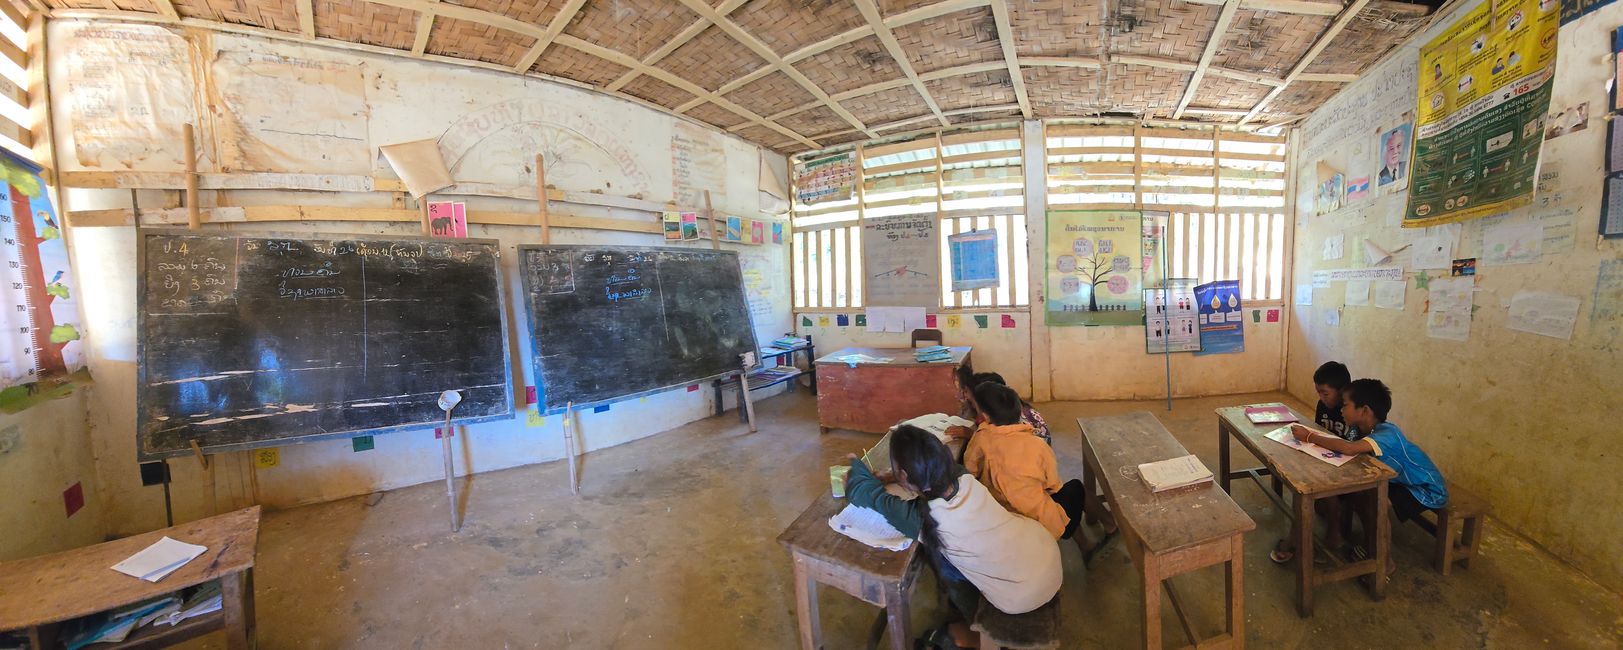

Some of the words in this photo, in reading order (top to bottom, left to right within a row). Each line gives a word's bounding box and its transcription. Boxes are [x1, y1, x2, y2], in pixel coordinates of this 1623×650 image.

[1513, 83, 1530, 95] 165
[0, 214, 11, 223] 150
[4, 237, 15, 246] 140
[9, 260, 19, 269] 130
[13, 282, 23, 291] 120
[16, 304, 27, 312] 110
[20, 326, 29, 334] 100
[24, 347, 31, 355] 90
